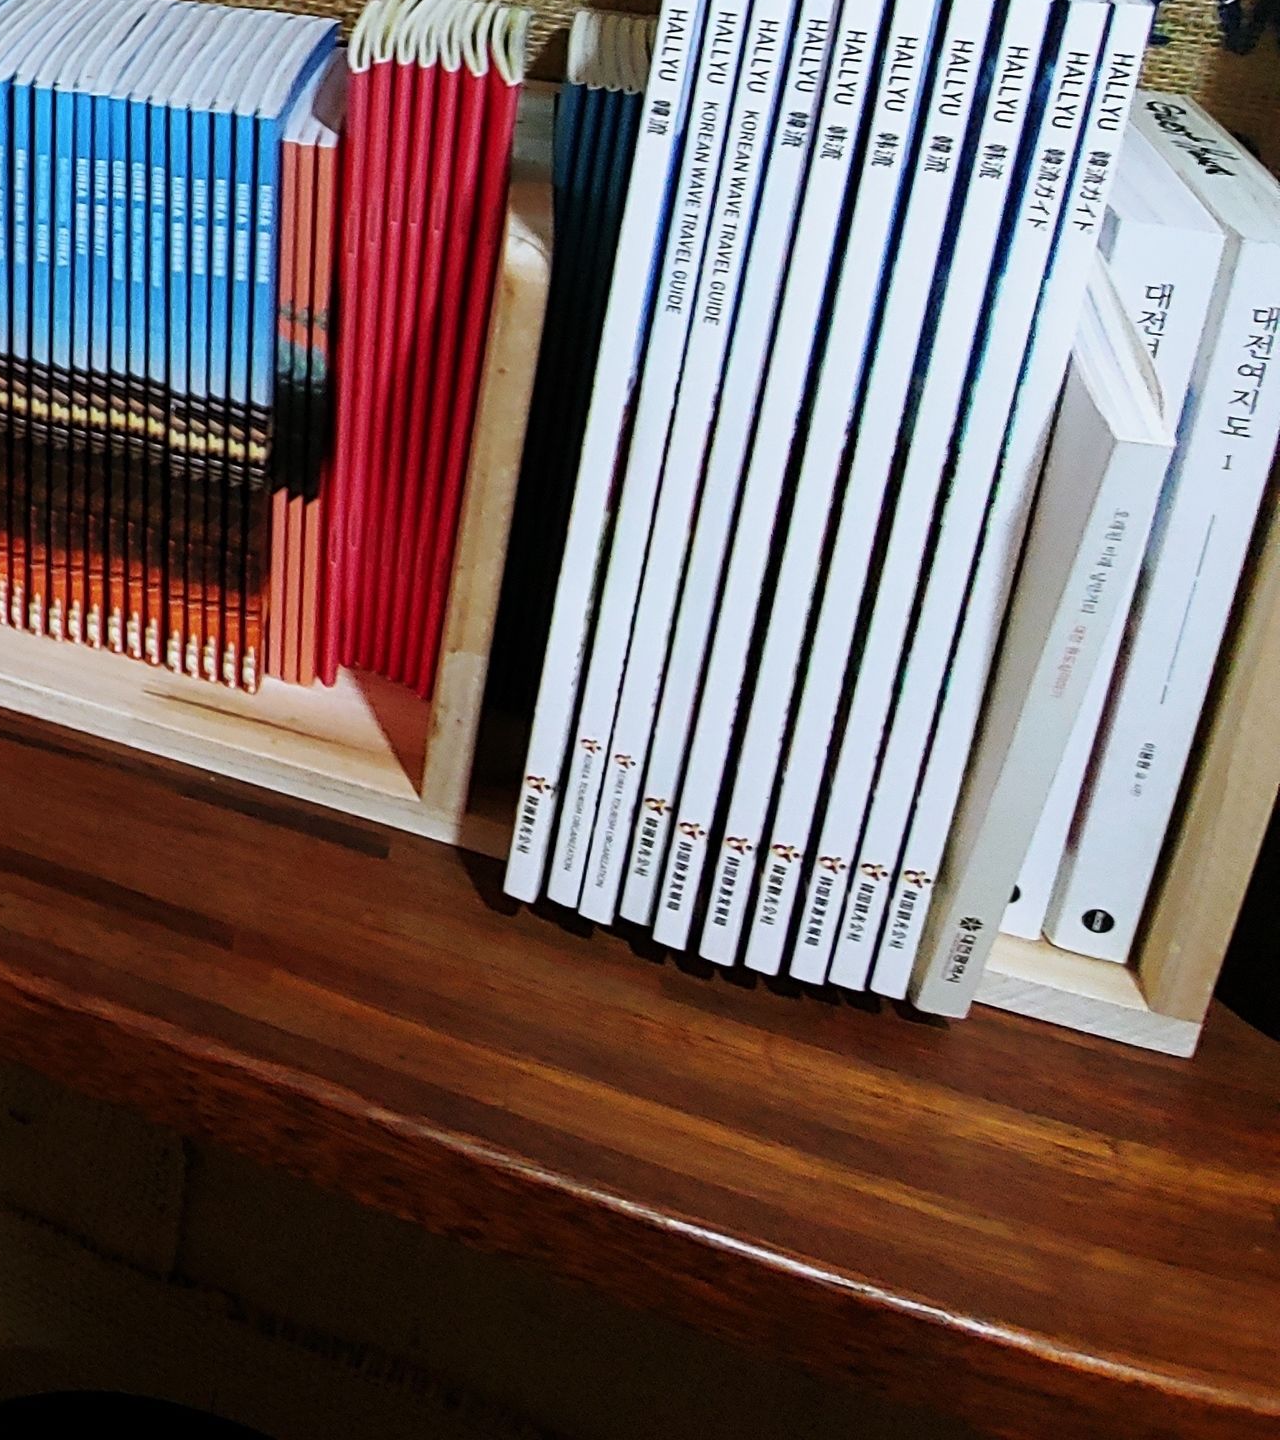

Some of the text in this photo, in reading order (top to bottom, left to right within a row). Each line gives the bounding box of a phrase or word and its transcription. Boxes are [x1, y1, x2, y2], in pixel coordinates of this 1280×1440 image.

[658, 9, 688, 82] HALLYU
[795, 19, 829, 93] HALLYU
[833, 30, 868, 106] HALLYU
[884, 36, 919, 112] HALLYU
[938, 39, 975, 116] HALLYU
[993, 46, 1029, 124] HALLYU
[1051, 52, 1089, 130] HALLYU
[1096, 53, 1136, 131] HALLYU
[665, 12, 738, 314] HALLYU KOREAN WAVE TRAVEL GUIDE
[703, 19, 780, 326] HALLYU KOREAN WAVE TRAVEL GUIDE
[1219, 307, 1280, 471] 대전여지도 1
